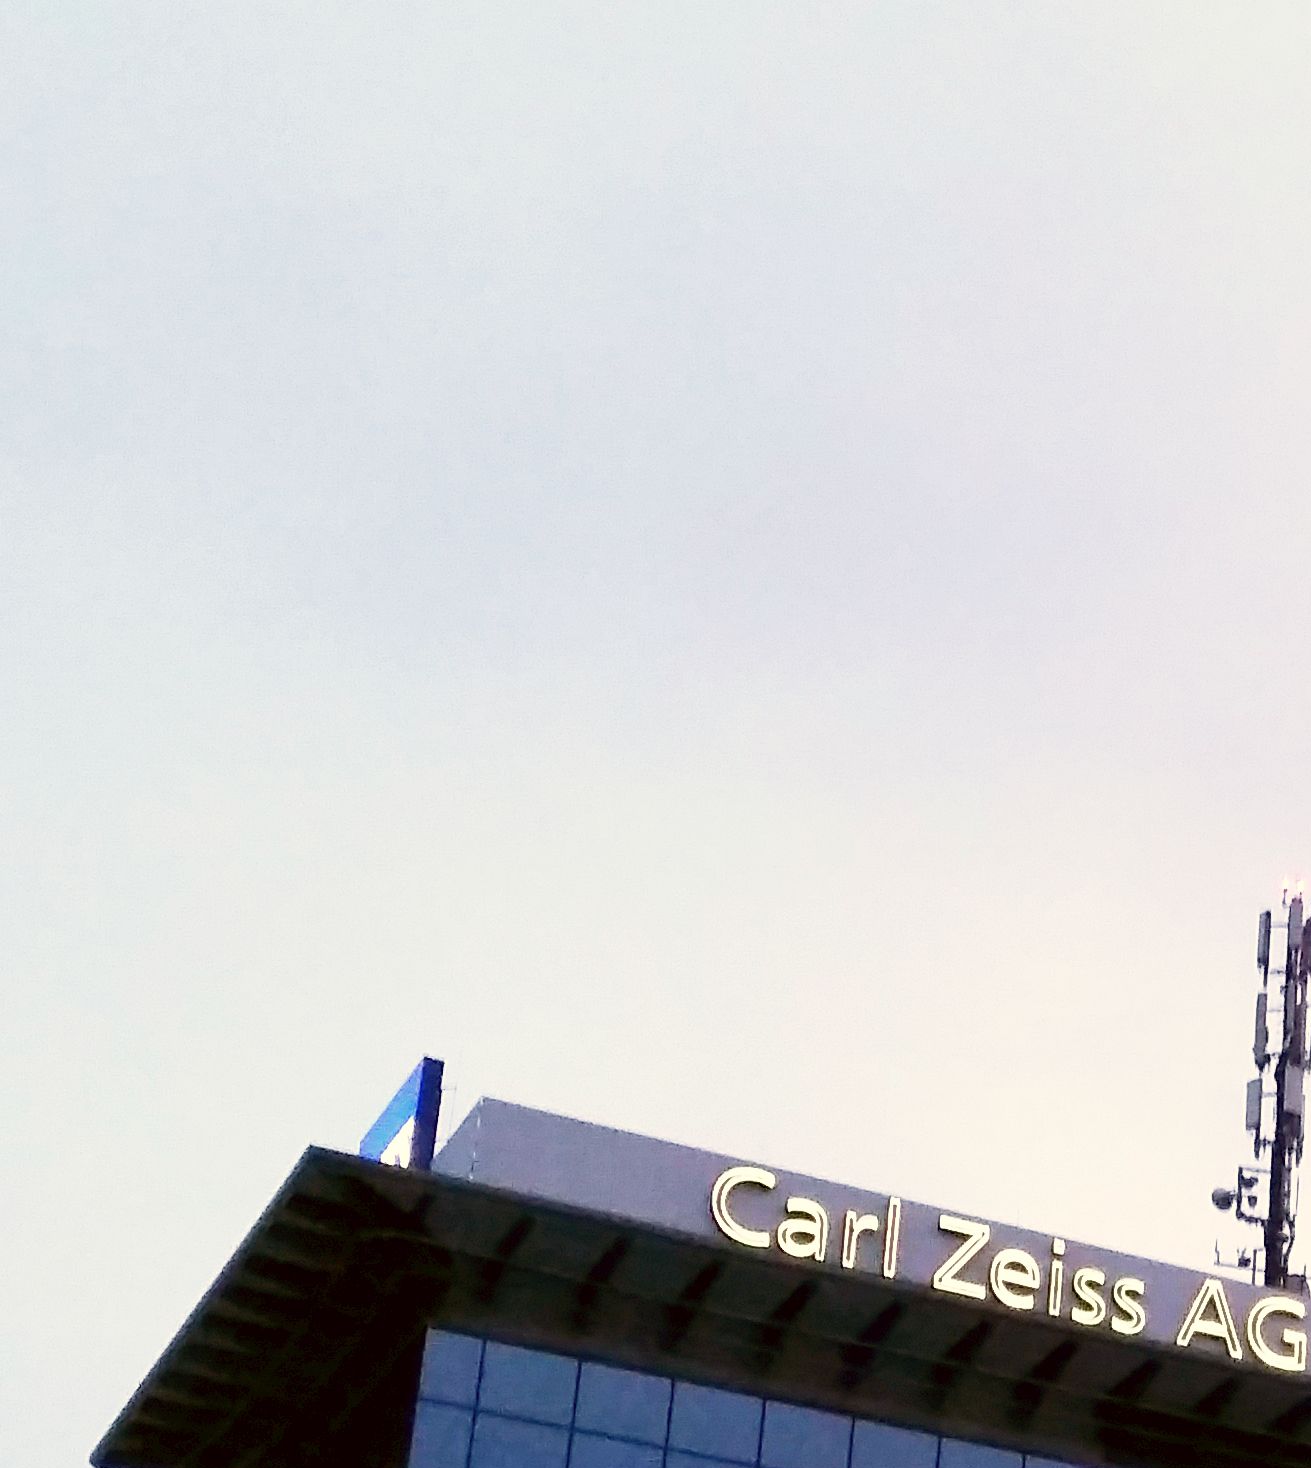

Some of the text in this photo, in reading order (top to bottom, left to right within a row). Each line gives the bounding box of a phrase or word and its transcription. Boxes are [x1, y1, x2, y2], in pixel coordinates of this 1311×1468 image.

[709, 1166, 1307, 1371] Carl Zeiss AG
